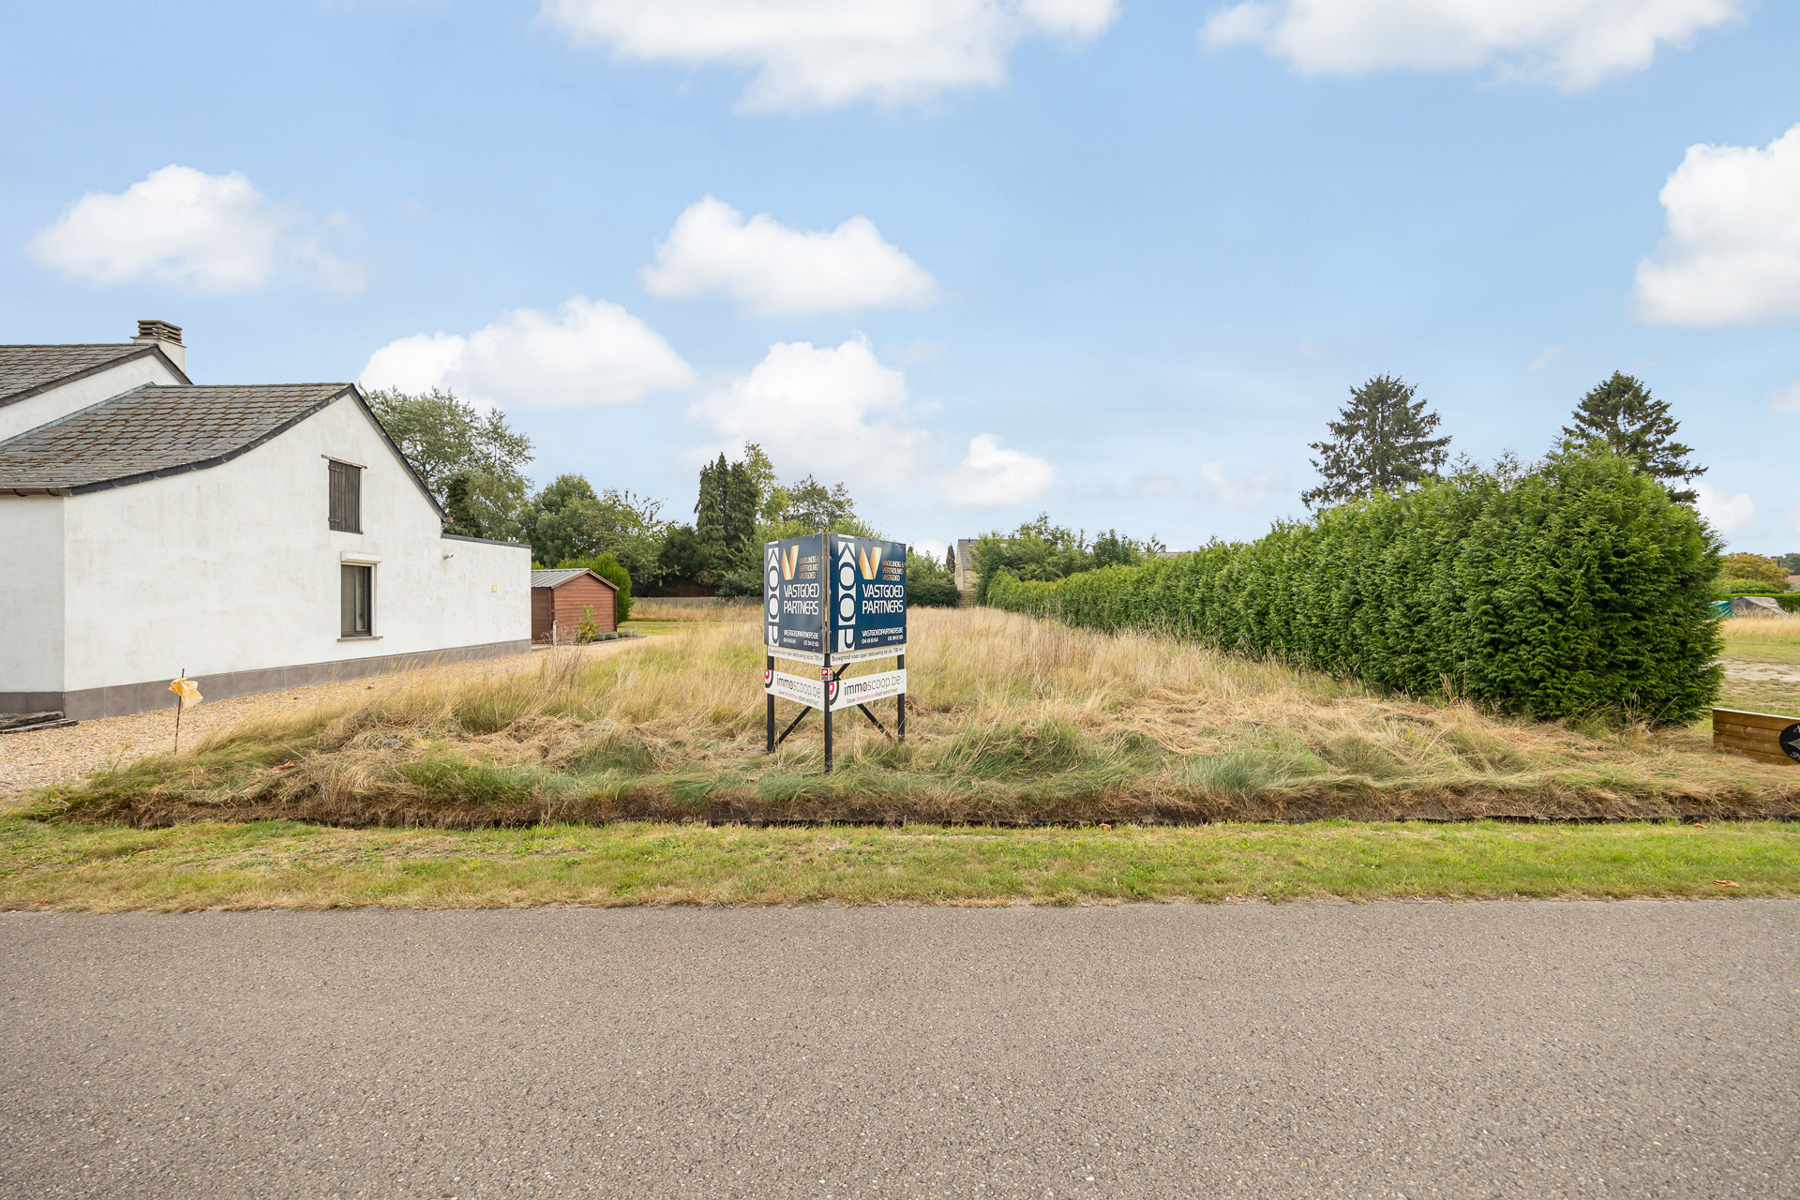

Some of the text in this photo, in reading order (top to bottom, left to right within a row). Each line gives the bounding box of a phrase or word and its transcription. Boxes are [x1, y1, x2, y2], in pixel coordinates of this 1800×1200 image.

[783, 583, 820, 598] VASTGOED
[837, 537, 857, 652] KOOP
[862, 584, 904, 598] VASTGOED
[783, 600, 819, 615] PARTNERS
[862, 600, 904, 614] PARTNERS
[777, 673, 821, 698] immoscoop.be
[844, 675, 901, 696] immoscoop.be
